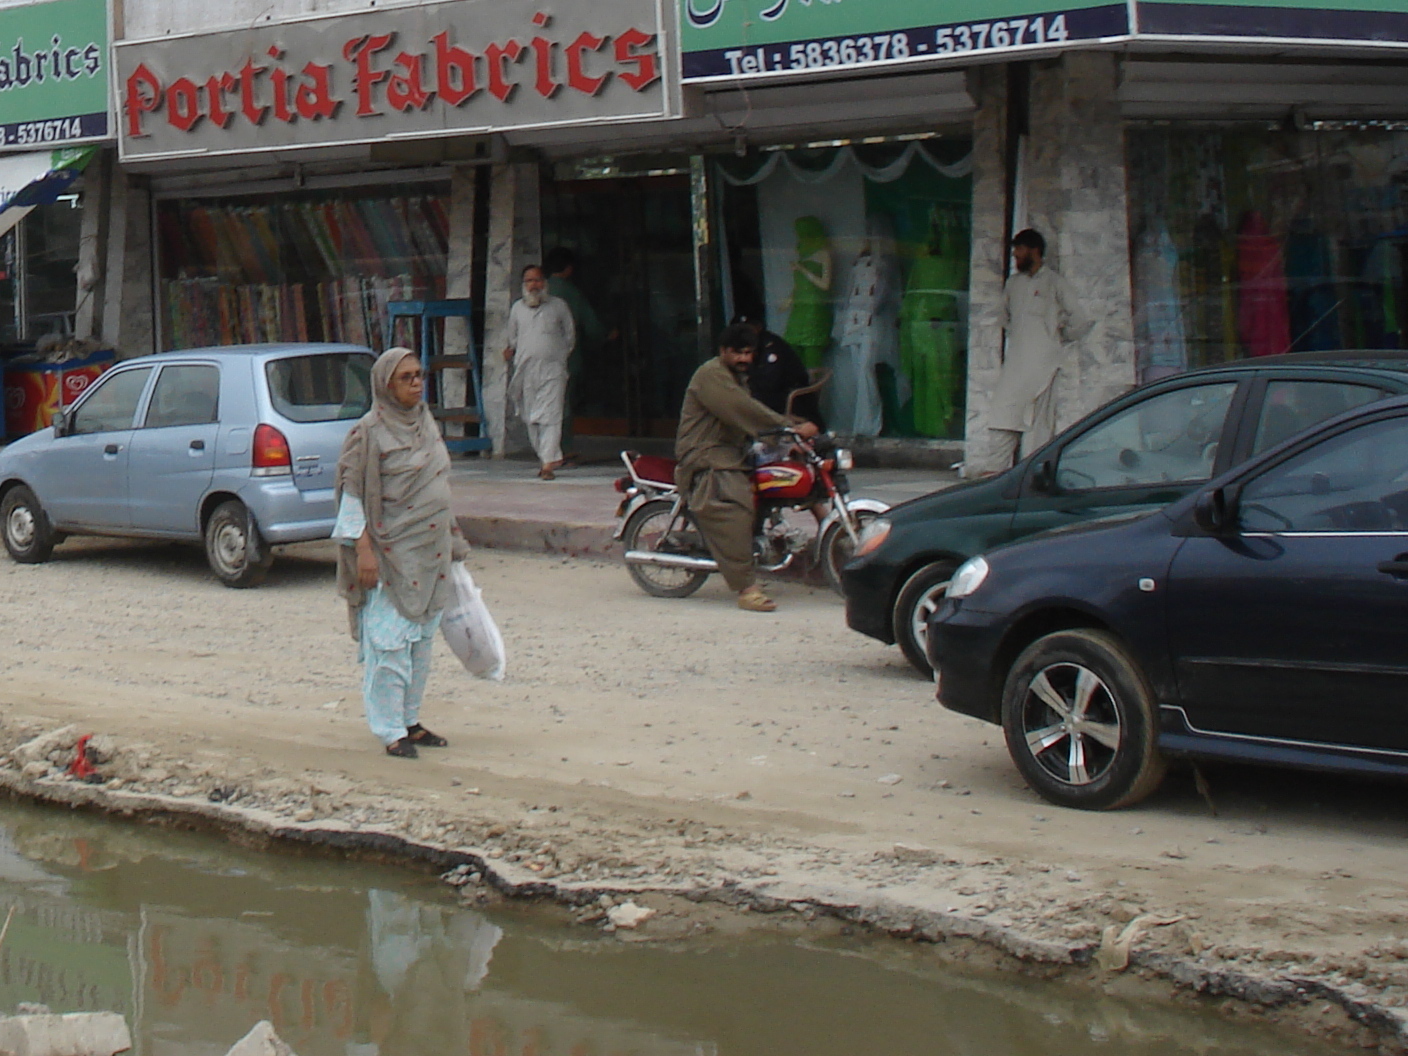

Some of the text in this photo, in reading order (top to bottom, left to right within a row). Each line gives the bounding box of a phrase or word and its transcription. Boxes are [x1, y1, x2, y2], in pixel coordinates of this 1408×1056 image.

[789, 32, 911, 71] 5836378
[935, 14, 1070, 56] 5376714
[123, 12, 661, 139] Portia Fabrics
[17, 116, 83, 144] 5376714
